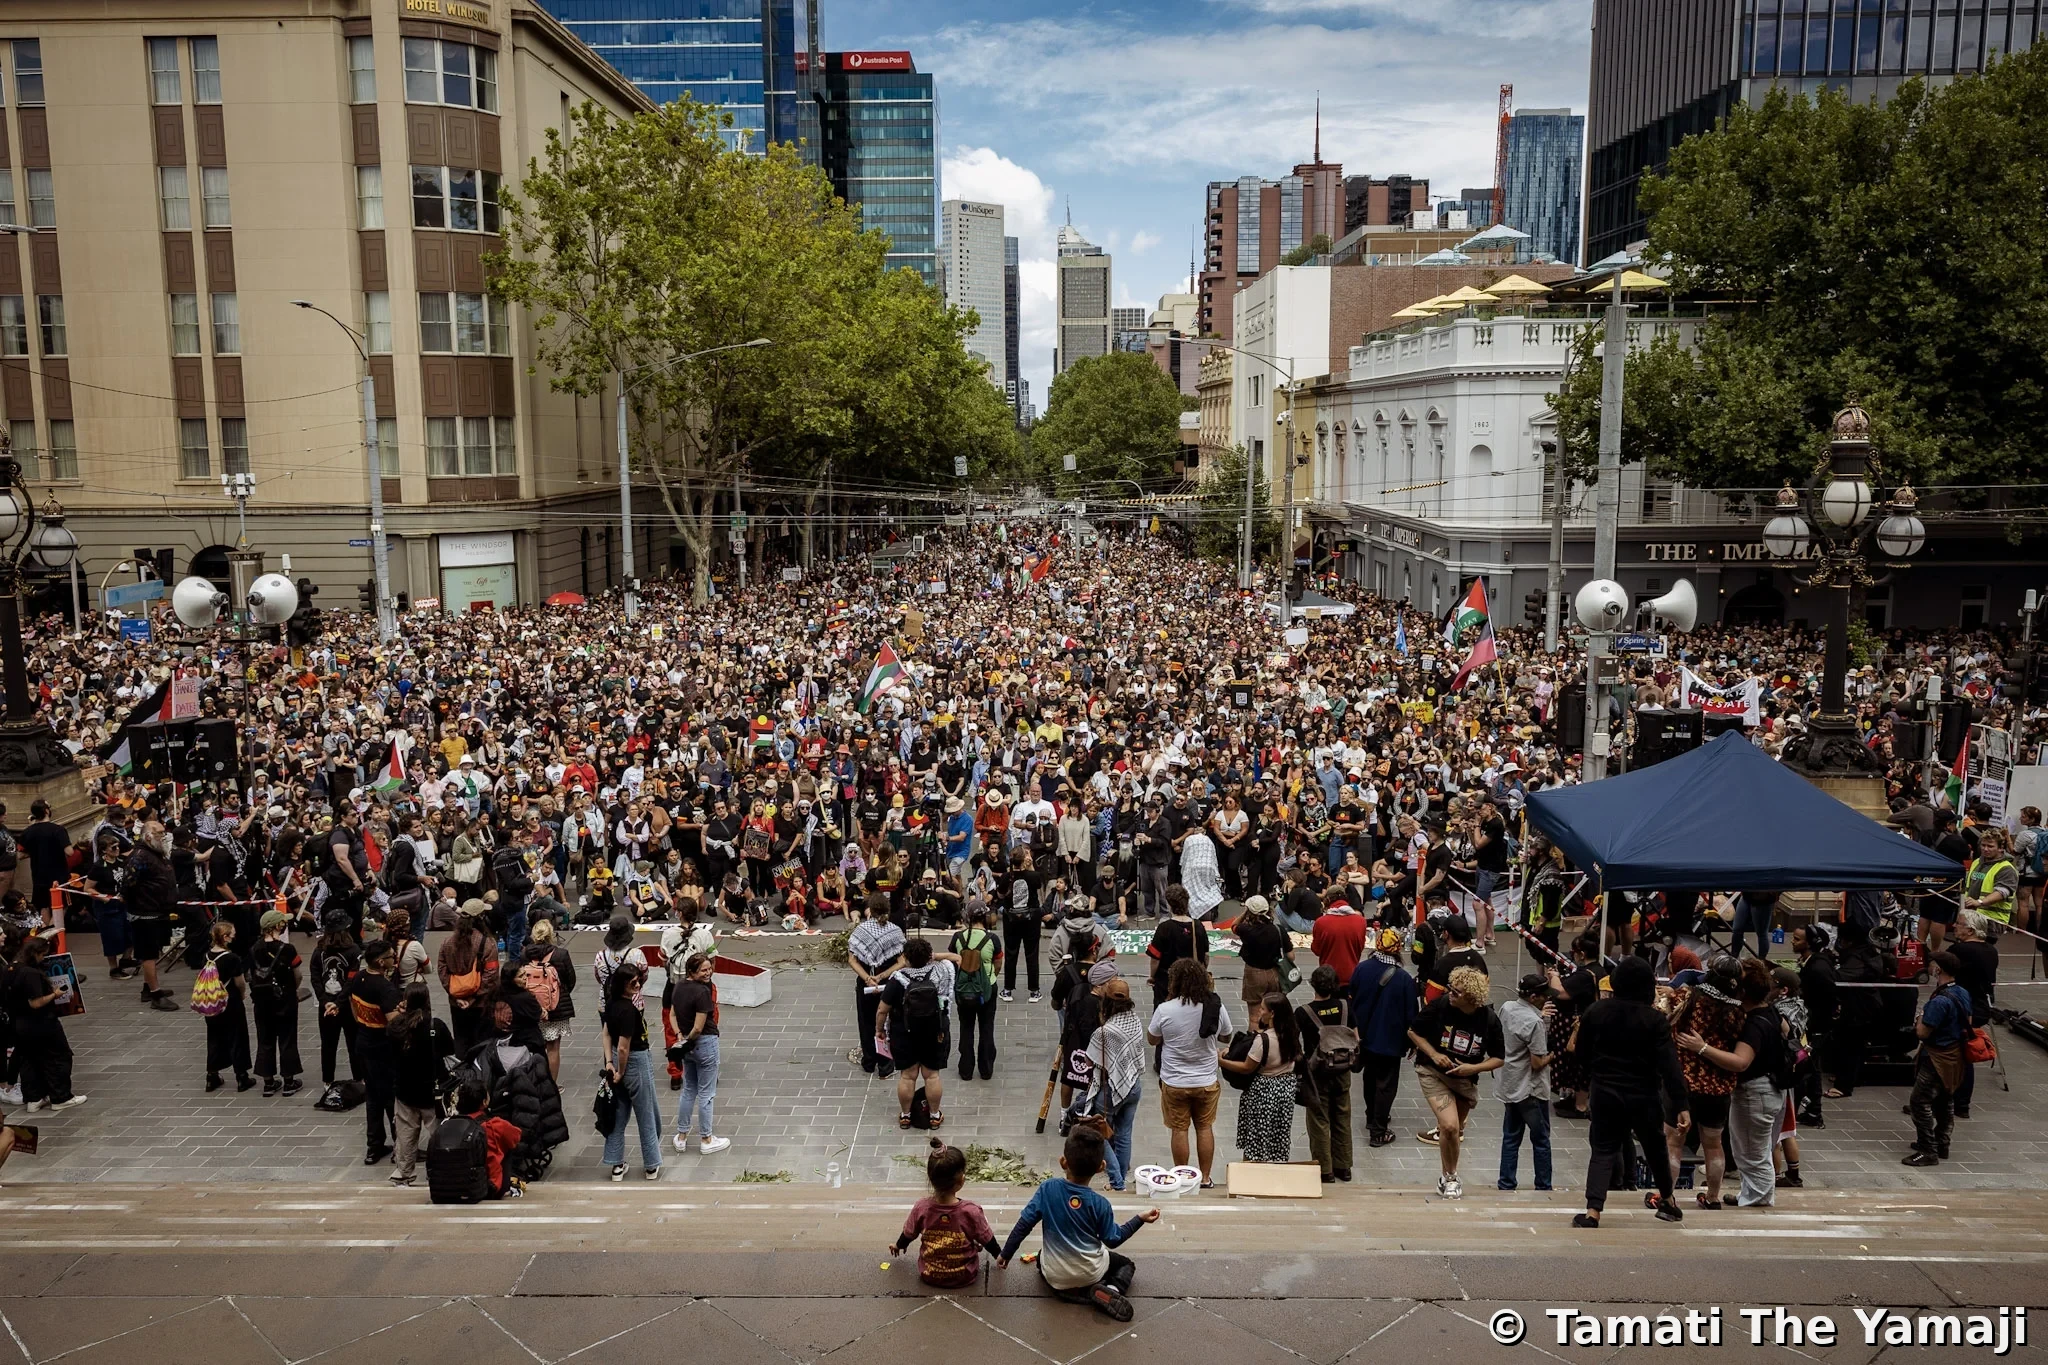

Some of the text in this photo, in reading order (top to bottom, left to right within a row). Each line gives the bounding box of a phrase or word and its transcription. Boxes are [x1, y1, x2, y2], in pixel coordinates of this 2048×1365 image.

[406, 0, 488, 24] HOTEL WINDSOR
[968, 204, 995, 216] UniSuper
[470, 541, 508, 549] WINDSOR
[1645, 543, 1824, 561] THE IMPIA
[1690, 692, 1751, 709] THE STATE
[1983, 782, 2004, 793] Justice
